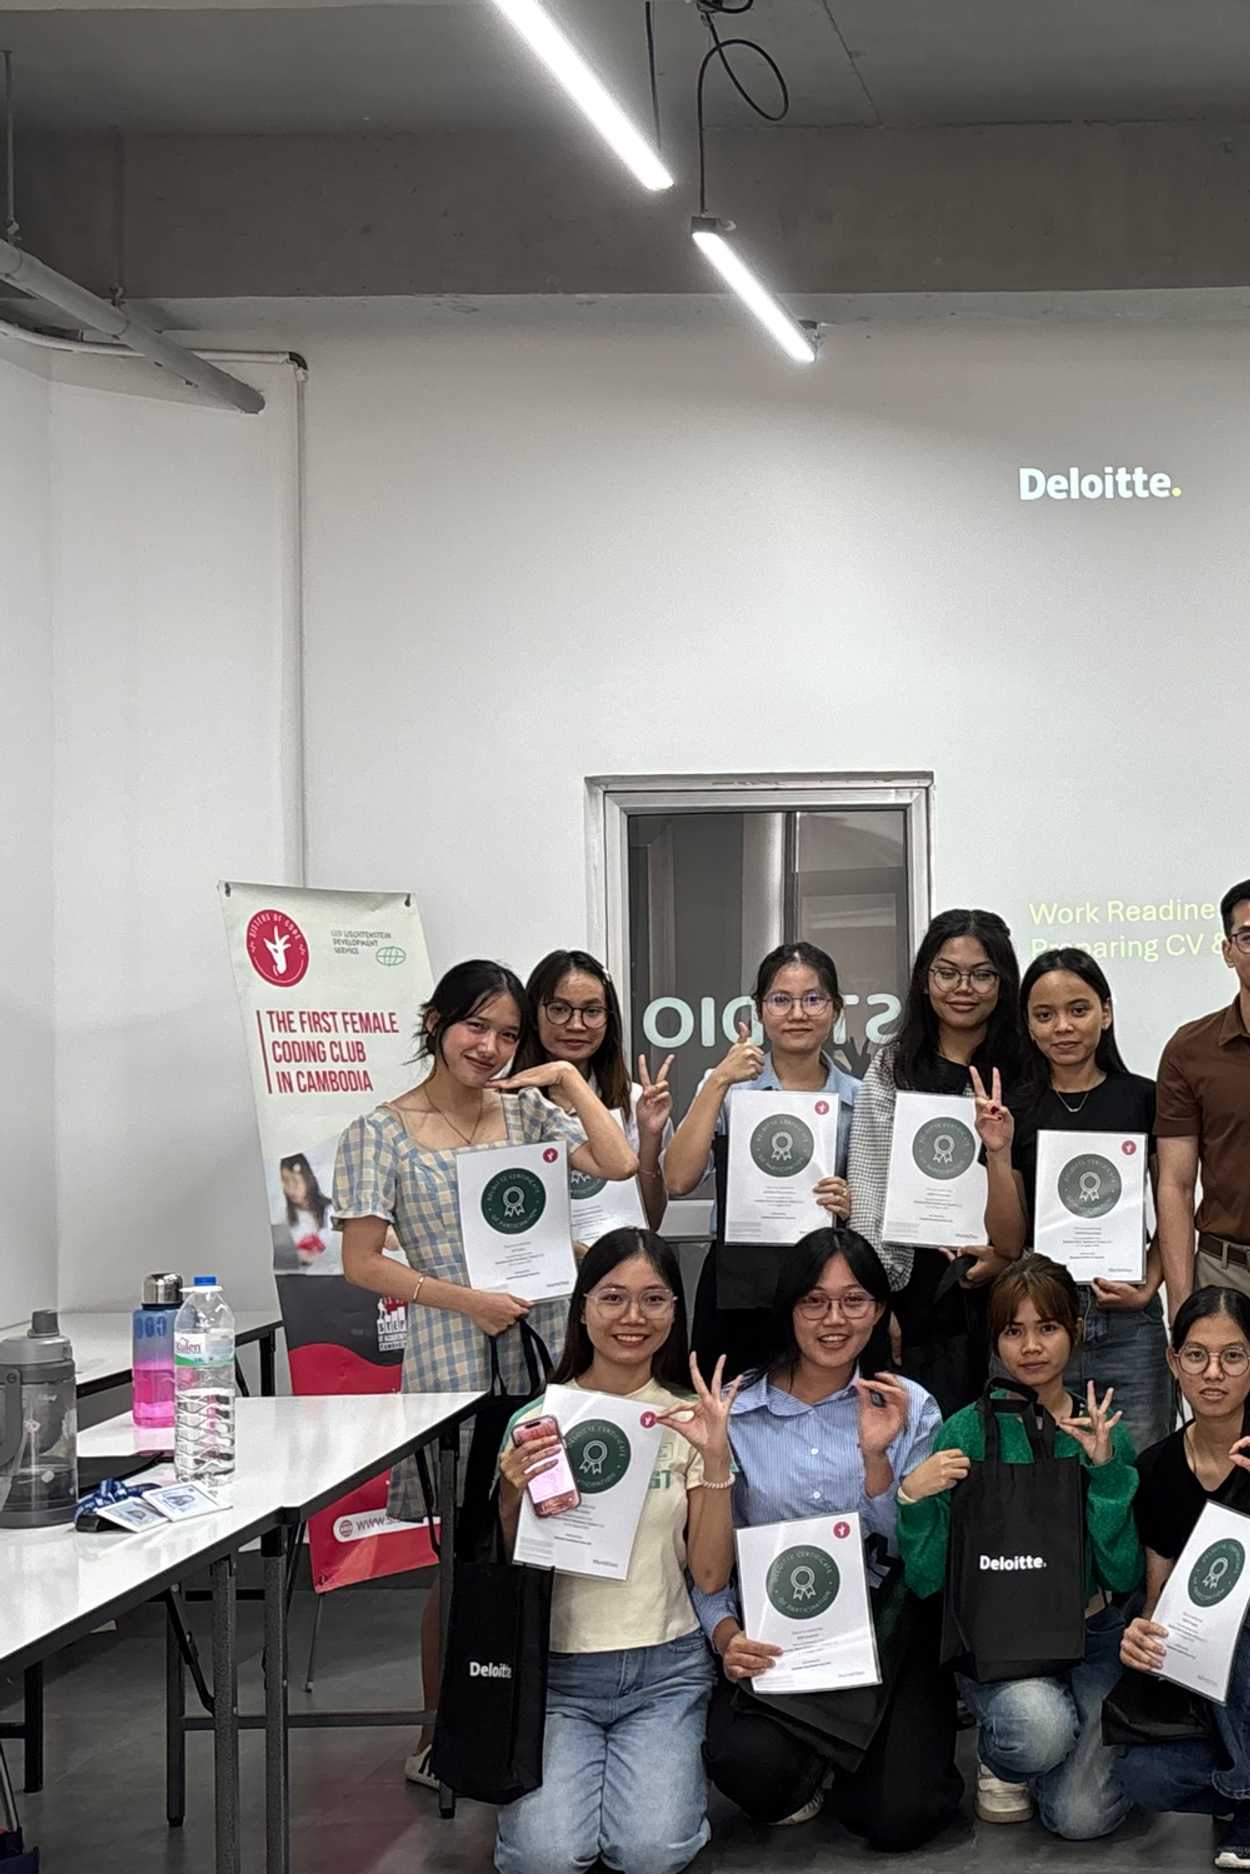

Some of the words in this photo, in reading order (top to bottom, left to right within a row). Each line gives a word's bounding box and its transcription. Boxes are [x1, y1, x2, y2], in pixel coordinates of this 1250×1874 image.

[1018, 465, 1182, 500] Deloitte.
[1028, 902, 1099, 925] Work
[1107, 898, 1220, 923] Readine
[1166, 933, 1204, 956] CV
[266, 1010, 297, 1033] THE
[299, 1011, 339, 1033] FIRST
[341, 1012, 399, 1033] FEMALE
[272, 1040, 327, 1063] CODING
[329, 1041, 366, 1063] CLUB
[276, 1071, 294, 1093] IN
[296, 1070, 373, 1093] CAMBODIA
[980, 1554, 1047, 1570] Deloitte.
